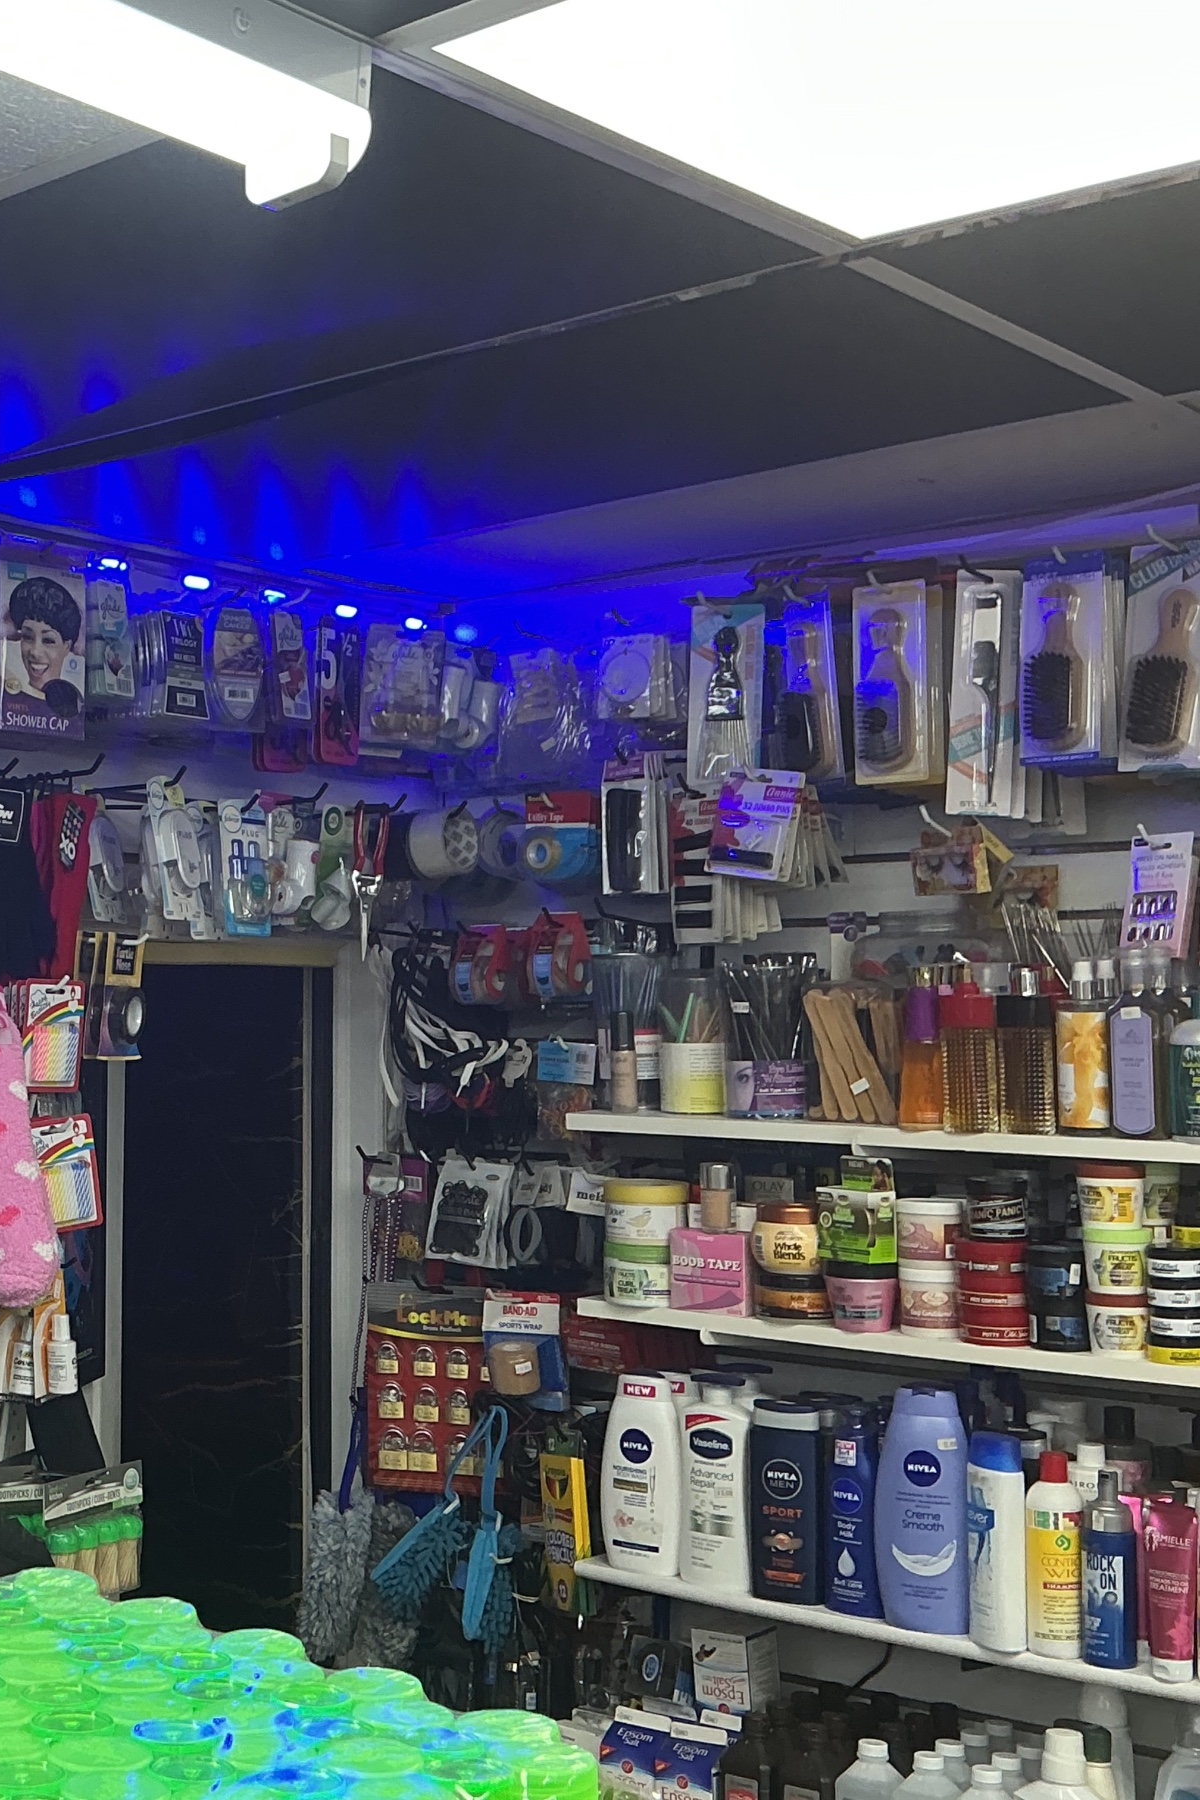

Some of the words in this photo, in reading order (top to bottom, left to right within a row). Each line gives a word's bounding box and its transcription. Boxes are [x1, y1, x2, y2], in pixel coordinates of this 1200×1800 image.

[1129, 559, 1168, 589] CLUB
[170, 636, 197, 648] TRILOGY
[6, 703, 30, 712] VINYL
[742, 802, 752, 810] 32
[753, 803, 775, 812] JUMBO
[776, 805, 791, 814] PINS
[528, 813, 548, 823] Utility
[549, 813, 565, 823] Tape
[241, 829, 260, 838] PLUG
[786, 1064, 805, 1073] Line
[752, 1180, 786, 1192] OLAY
[995, 1205, 1022, 1218] PANIC
[774, 1242, 803, 1251] Whole
[773, 1250, 806, 1260] Blends
[673, 1255, 705, 1268] BOOB
[707, 1258, 742, 1271] TAPE
[502, 1305, 538, 1317] BAND-AID
[498, 1321, 522, 1330] SPORTS
[523, 1322, 543, 1331] WRAP
[1105, 1319, 1136, 1327] FRUCTIS
[626, 1386, 650, 1396] NEW
[623, 1441, 650, 1451] NIVEA
[613, 1464, 647, 1475] NOURISHING
[690, 1467, 734, 1481] Advanced
[907, 1464, 938, 1474] NIVEA
[690, 1476, 715, 1488] Repair
[766, 1470, 798, 1482] NIVEA
[769, 1480, 795, 1489] MEN
[833, 1490, 860, 1501] NIVEA
[762, 1505, 803, 1518] SPORT
[904, 1509, 941, 1522] Creme
[837, 1520, 856, 1531] Body
[902, 1519, 945, 1533] Smooth
[839, 1530, 854, 1538] Milk
[1158, 1533, 1192, 1546] MIELLE
[1086, 1552, 1116, 1573] ROCK
[1100, 1572, 1117, 1590] ON
[713, 1675, 731, 1689] Salt
[702, 1684, 744, 1705] Epsom
[617, 1727, 654, 1743] Epsom
[624, 1736, 640, 1747] Salt
[672, 1742, 709, 1757] Epsom
[678, 1751, 695, 1762] Salt
